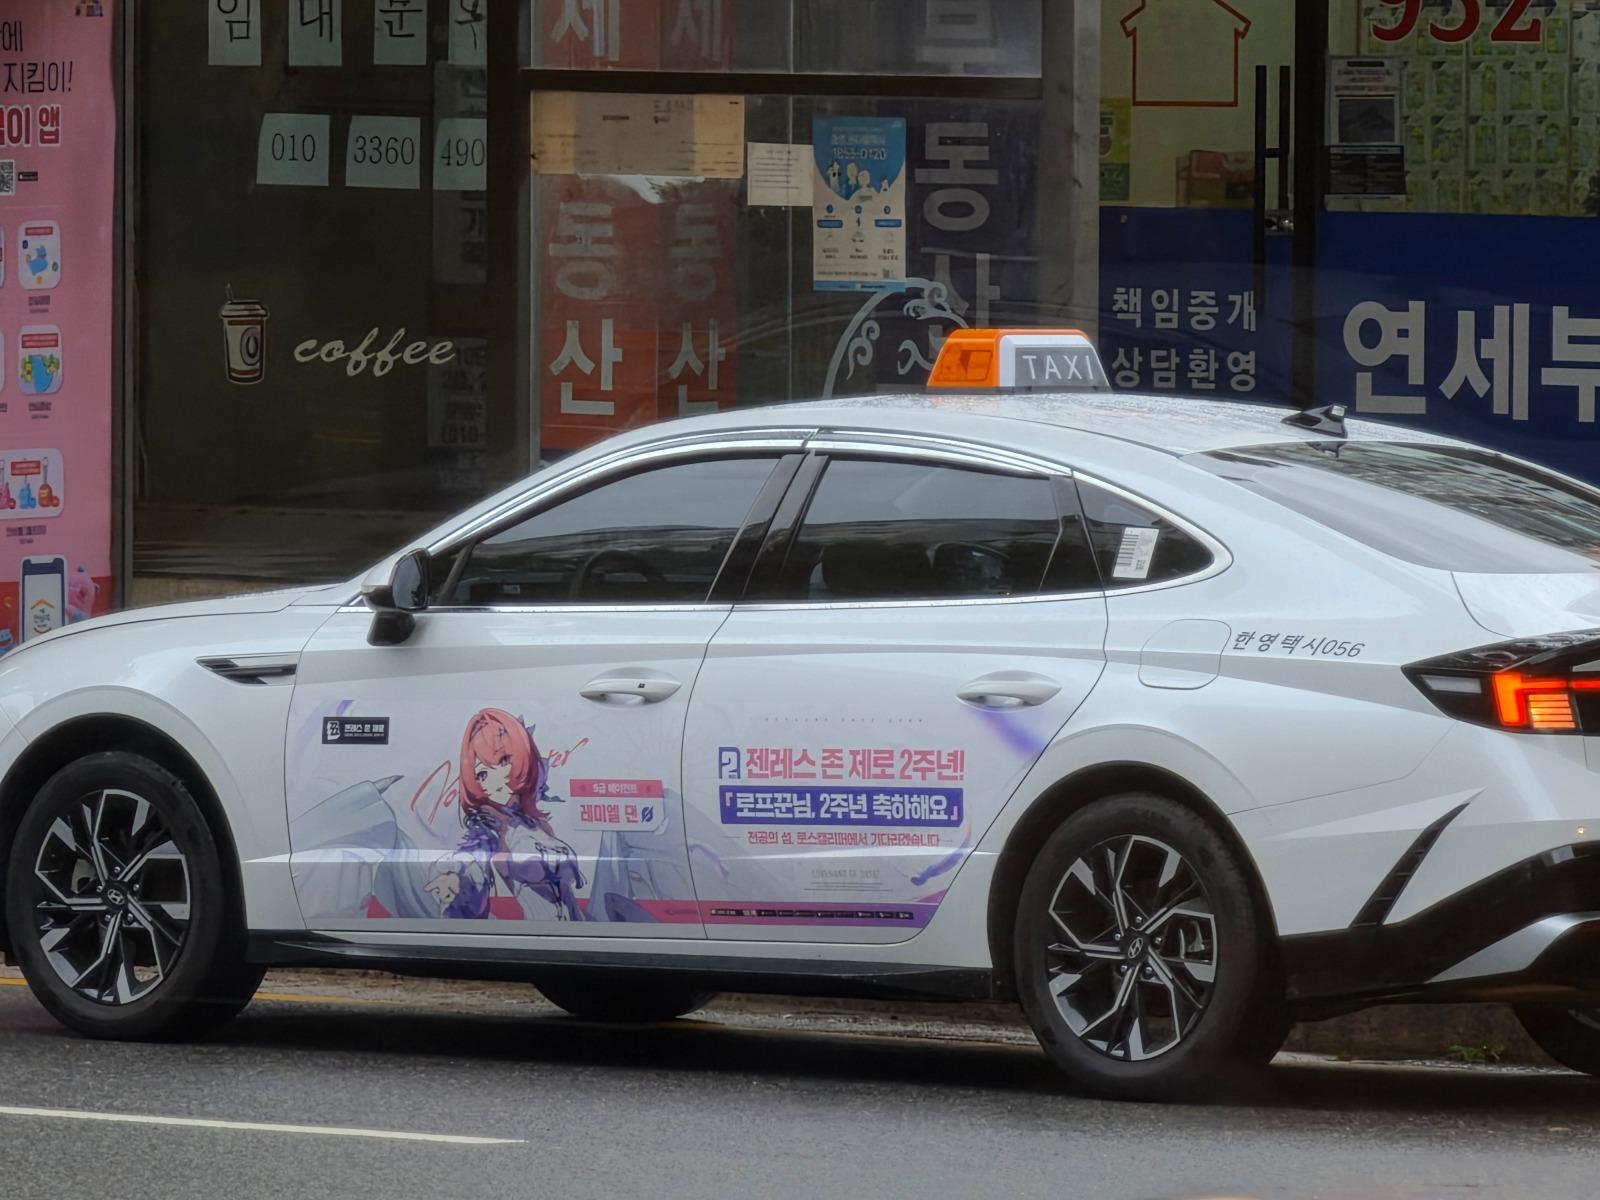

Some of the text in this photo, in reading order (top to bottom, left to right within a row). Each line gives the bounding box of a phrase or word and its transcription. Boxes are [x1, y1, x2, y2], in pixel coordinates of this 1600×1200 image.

[0, 21, 23, 52] 에
[4, 61, 73, 93] 지킴이!
[0, 105, 62, 146] 이 앱
[271, 134, 316, 162] 010
[353, 135, 415, 166] 3360
[1112, 287, 1257, 332] 책임중개
[293, 327, 455, 377] coffee
[1022, 355, 1094, 380] TAXI
[1343, 301, 1600, 423] 연세부
[1112, 347, 1257, 392] 상담환영
[746, 748, 965, 781] 젠레스 존 제로 2주년!
[579, 804, 620, 823] 레미엘
[820, 793, 868, 819] 2주년
